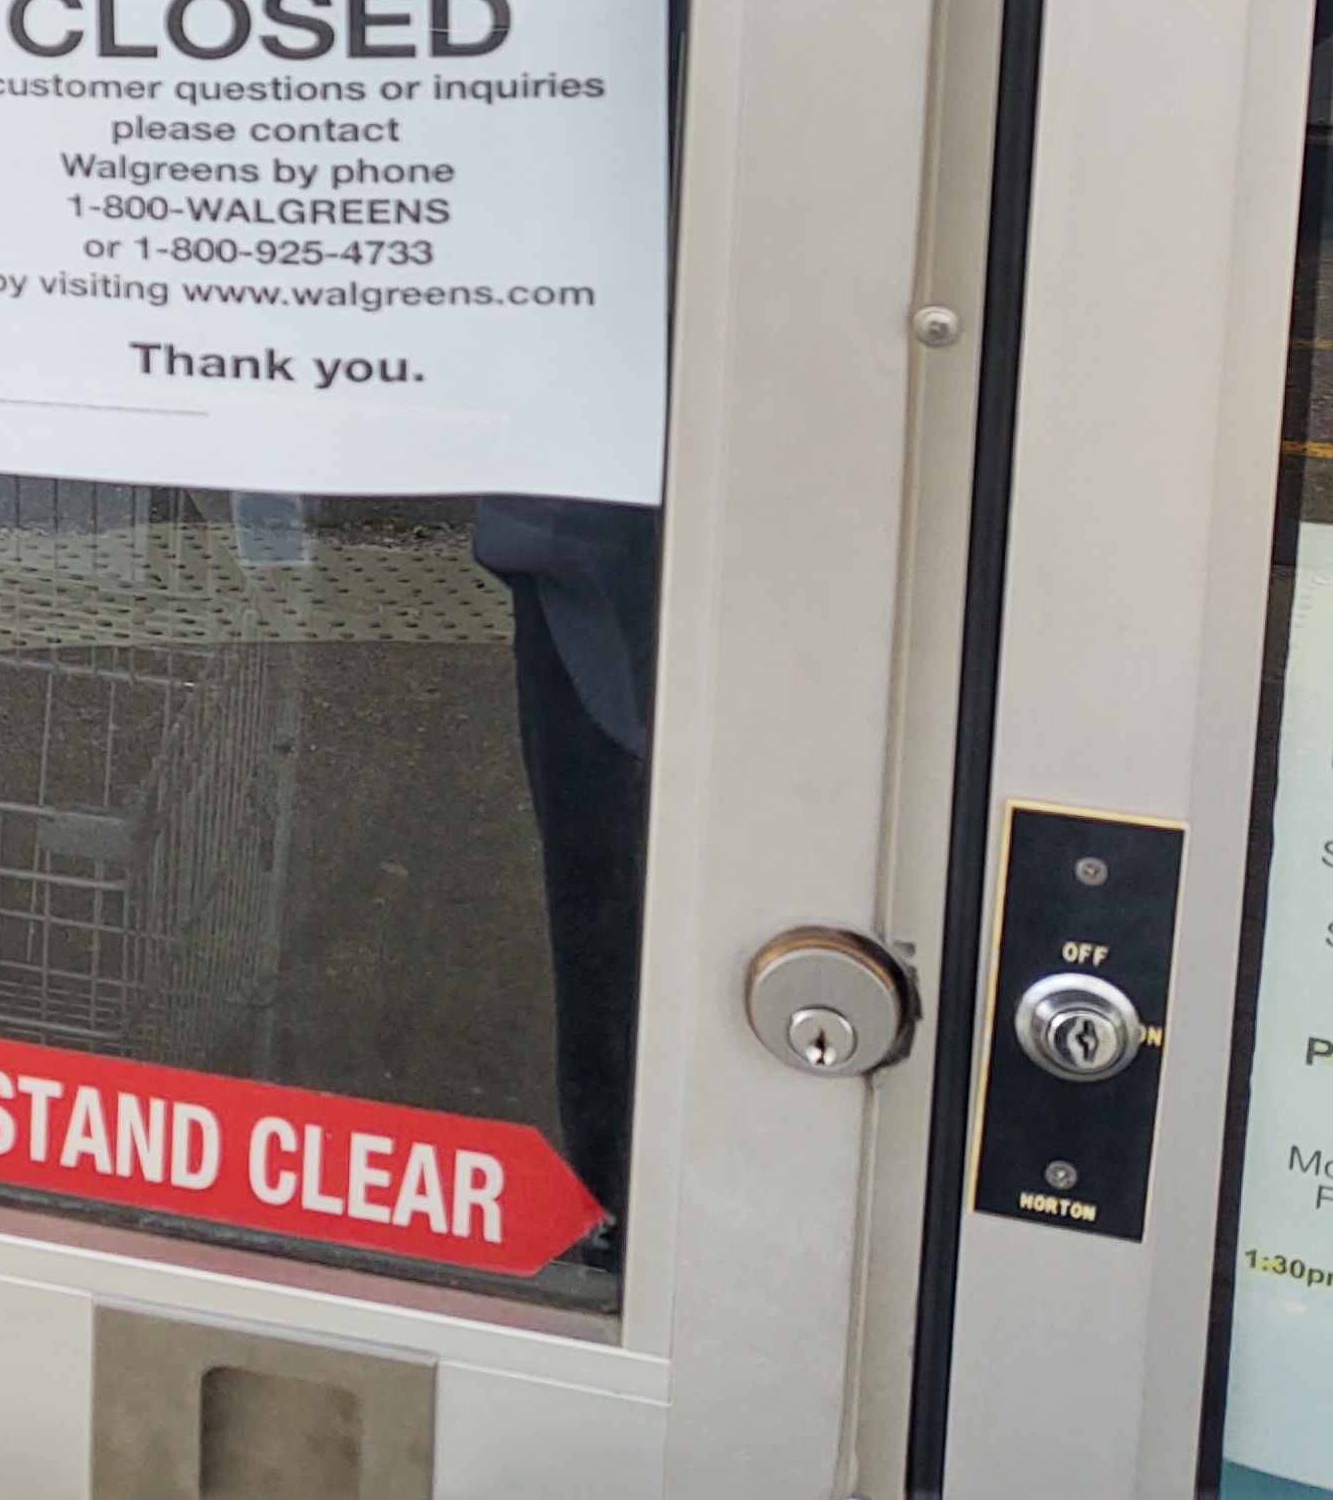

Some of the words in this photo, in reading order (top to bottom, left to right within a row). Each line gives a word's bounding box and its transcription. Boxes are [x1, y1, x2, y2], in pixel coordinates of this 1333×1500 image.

[174, 76, 366, 105] questions
[380, 77, 420, 101] or
[434, 72, 606, 104] inquiries
[111, 116, 236, 145] please
[250, 117, 400, 143] contact
[59, 154, 259, 186] Walgreens
[273, 158, 319, 187] by
[331, 159, 456, 189] phone
[67, 195, 451, 226] 1-800-WALGREENS
[83, 236, 122, 261] or
[134, 237, 433, 266] 1-800-925-4733
[40, 270, 169, 306] visiting
[182, 279, 596, 310] www.walgreens.com
[129, 342, 295, 382] Thank
[314, 350, 426, 389] you.
[1062, 943, 1109, 966] OFF
[248, 1114, 504, 1243] CLEAR
[1020, 1192, 1096, 1223] HORTON
